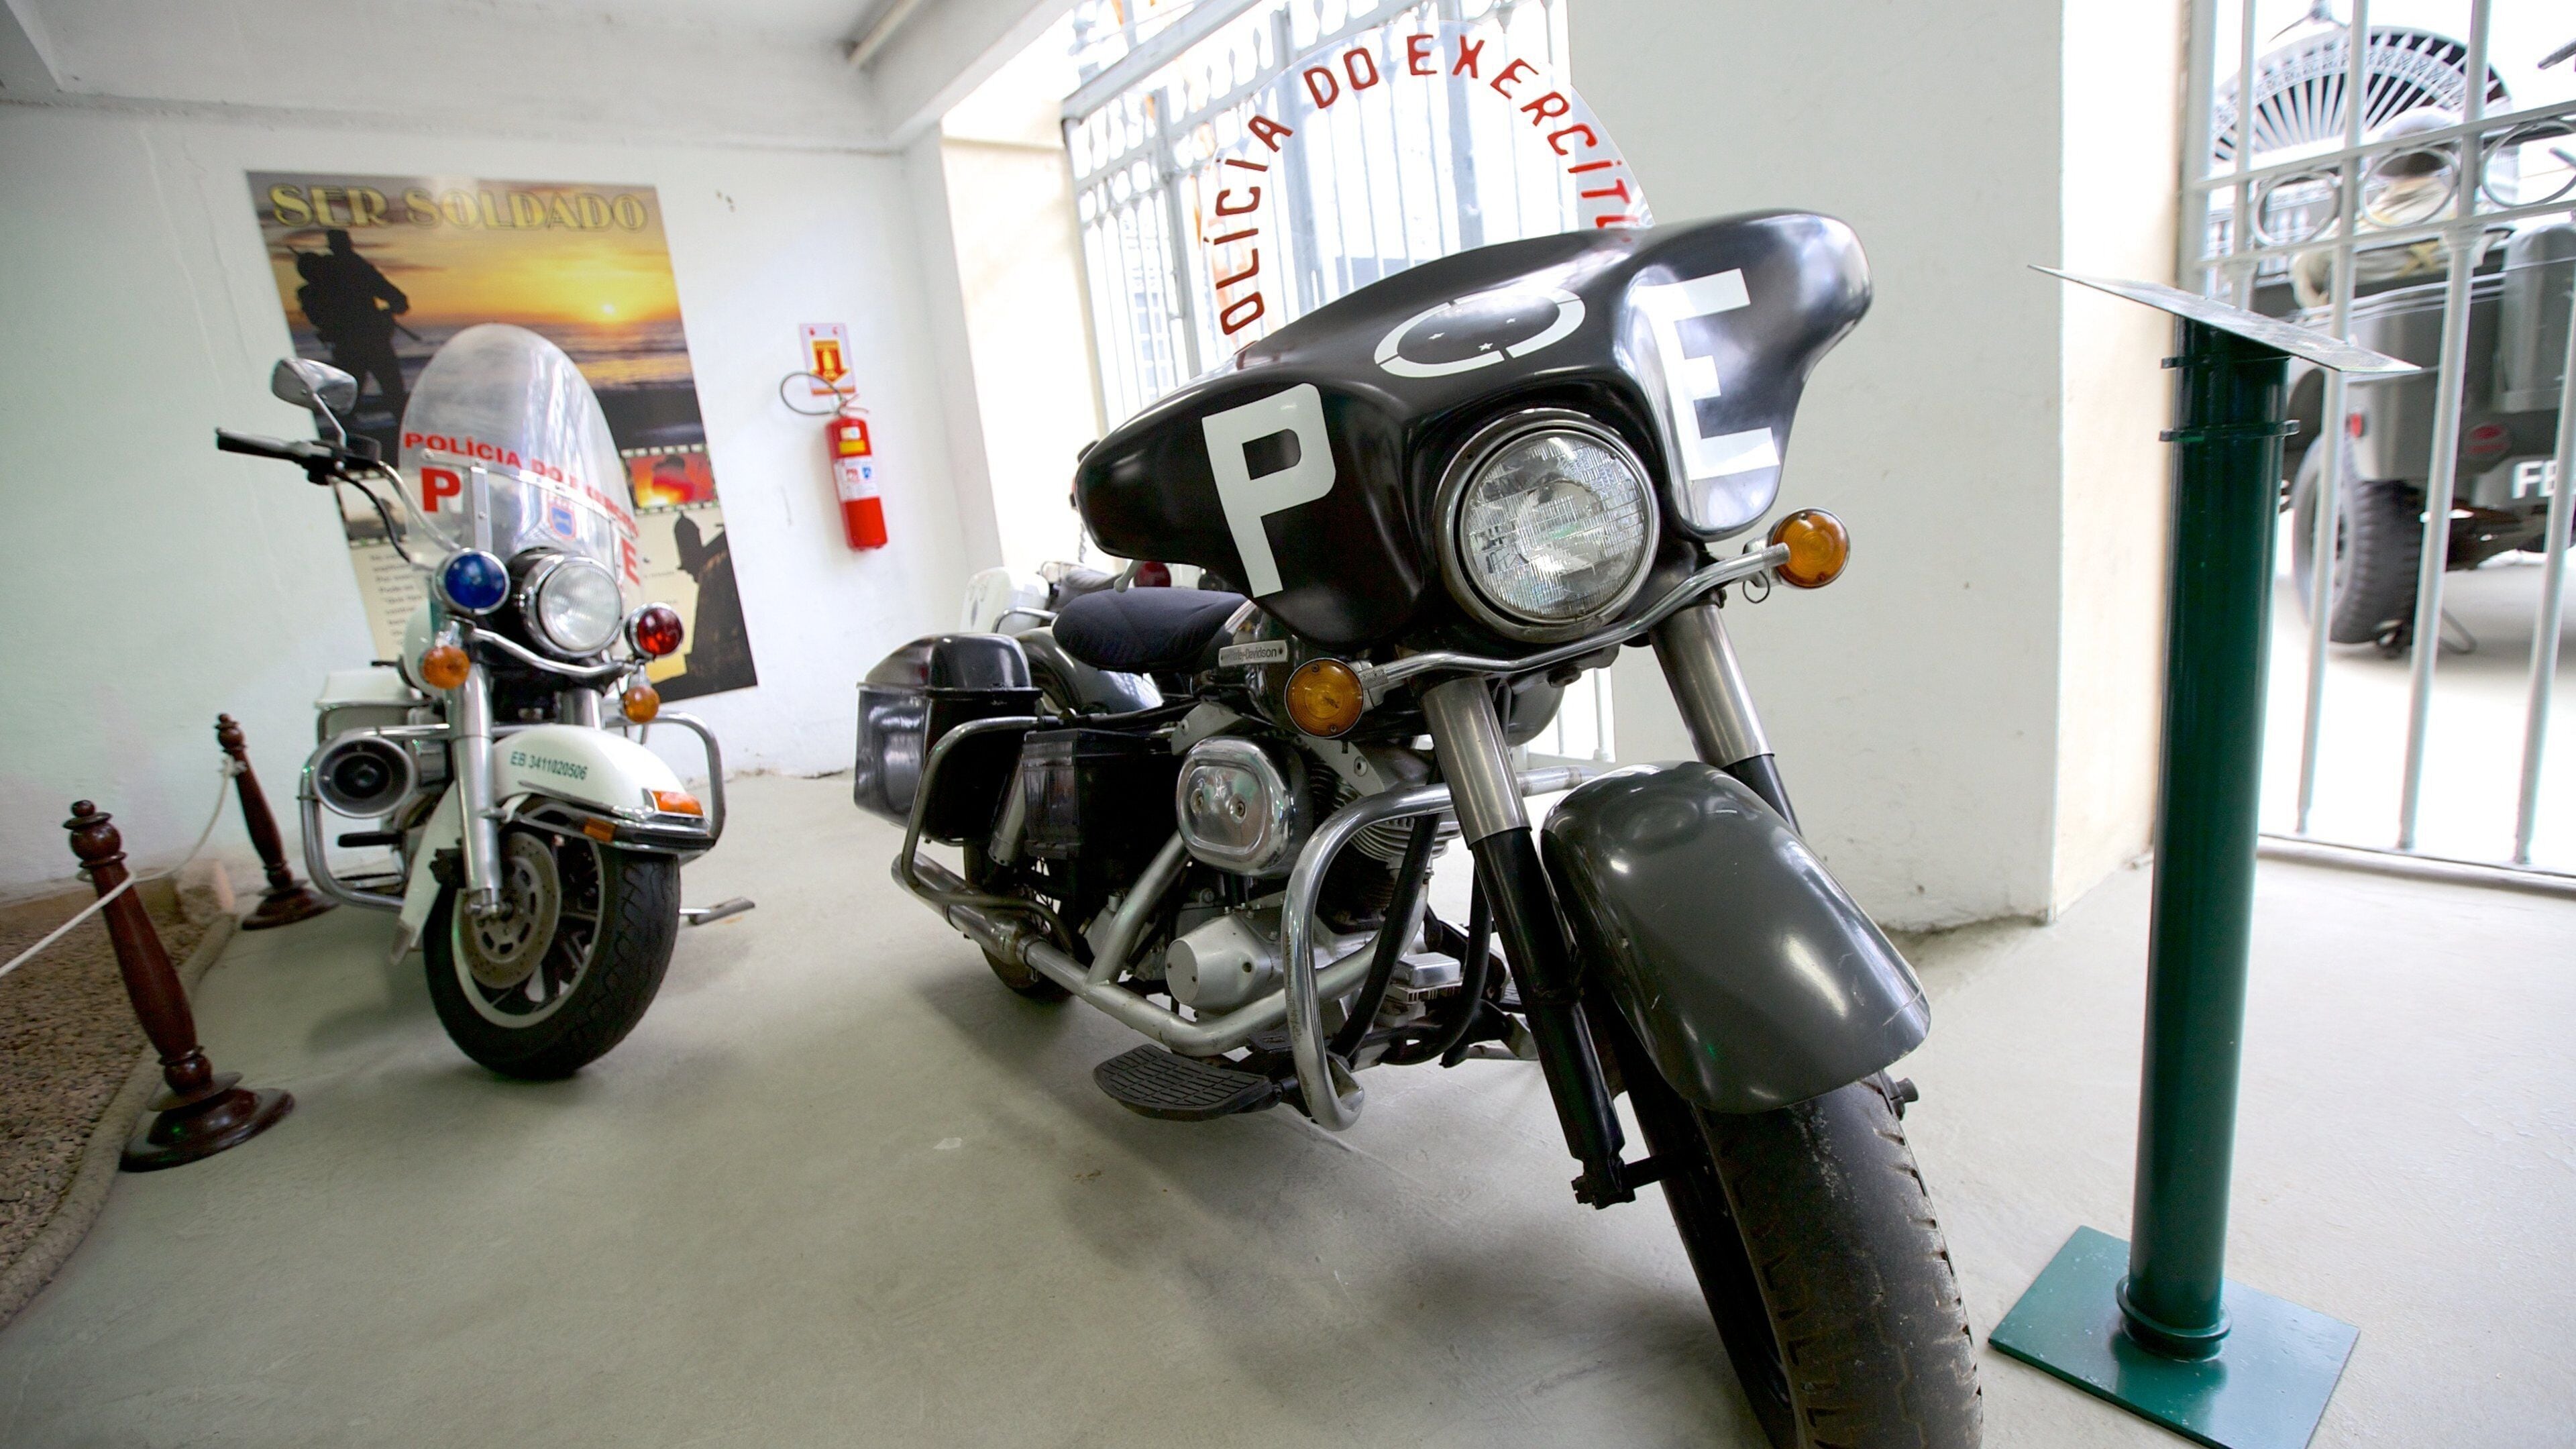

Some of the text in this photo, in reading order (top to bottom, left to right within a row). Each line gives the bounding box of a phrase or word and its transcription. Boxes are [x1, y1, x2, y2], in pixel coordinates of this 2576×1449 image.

[1303, 46, 1380, 109] DO
[270, 184, 649, 233] SER SOLDADO
[1201, 268, 1781, 598] P E
[419, 466, 640, 586] P E
[511, 751, 526, 767] EB
